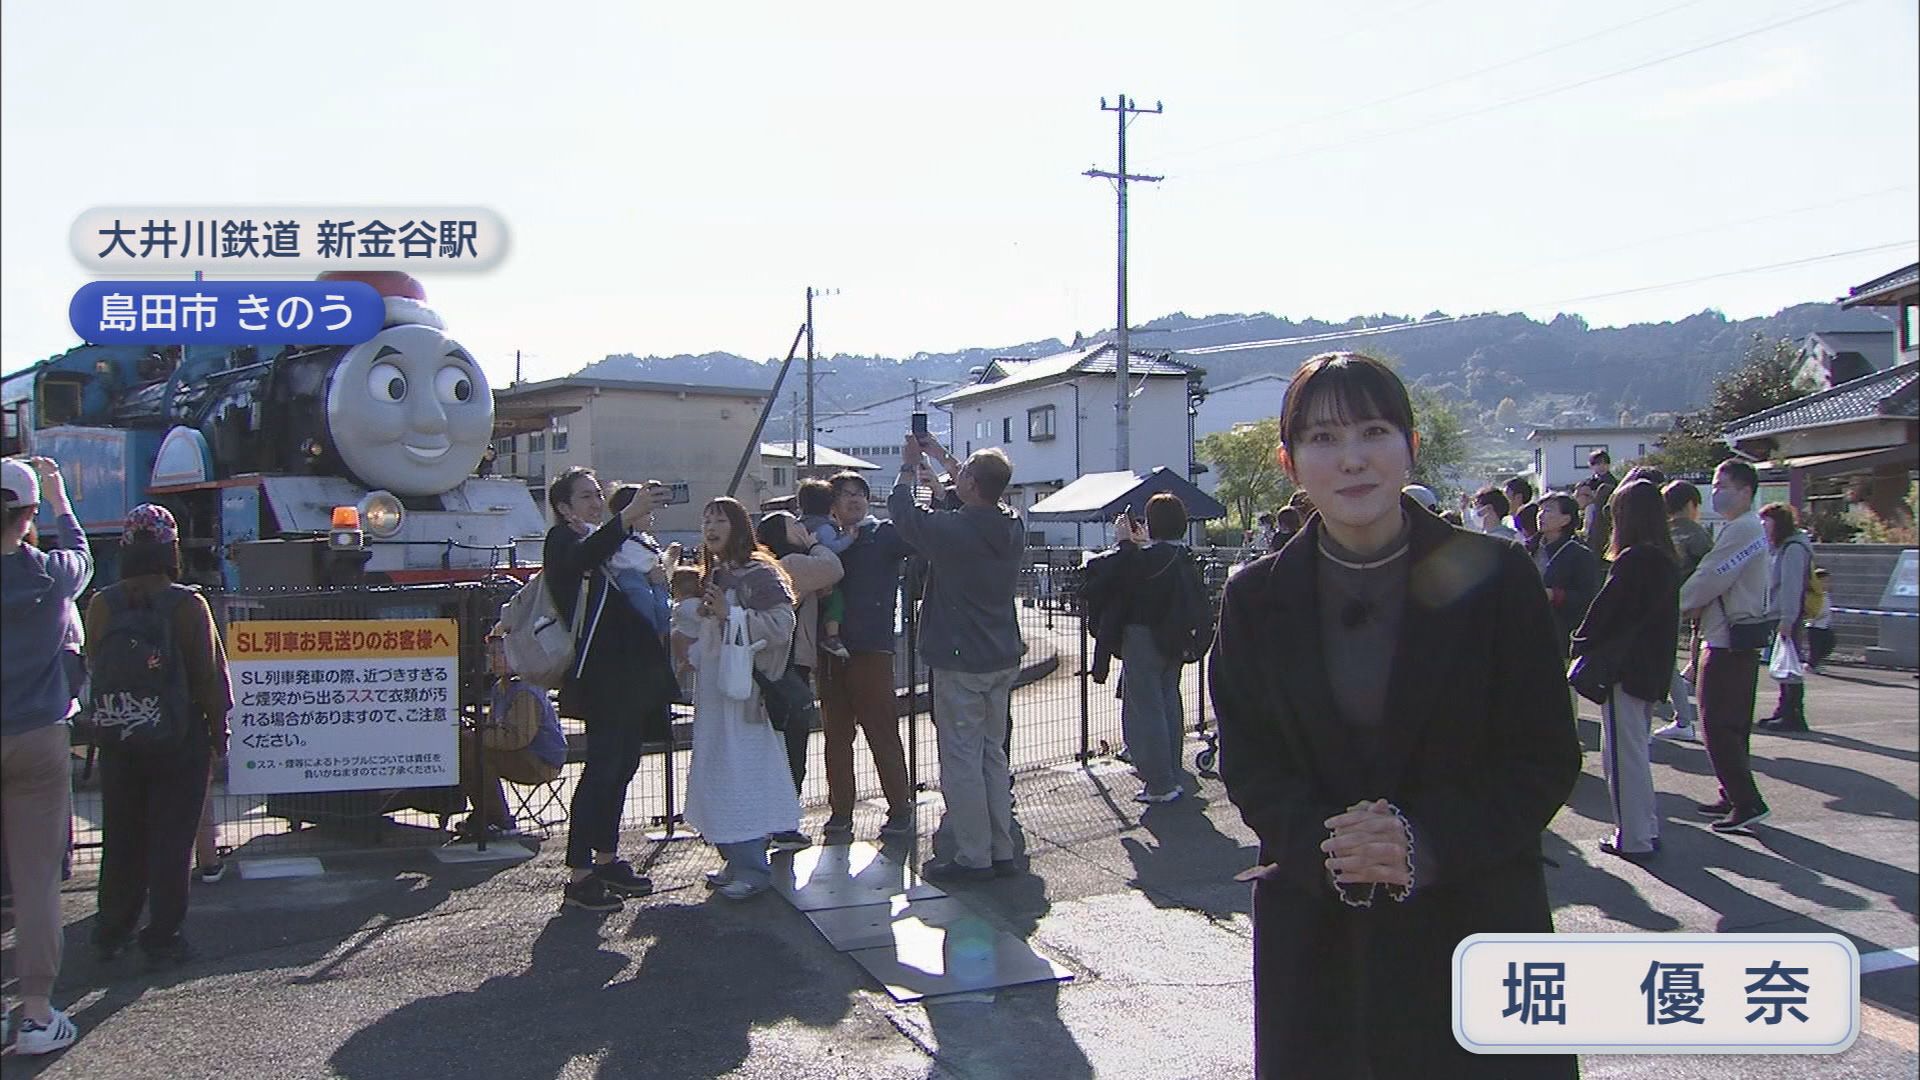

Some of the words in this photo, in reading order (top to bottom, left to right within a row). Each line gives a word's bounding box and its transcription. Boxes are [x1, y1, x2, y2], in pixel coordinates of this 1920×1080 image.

[237, 628, 449, 653] SL列車お見送りのお客様へ
[241, 667, 448, 686] SL列車発車の際、近づきすぎる
[241, 687, 447, 706] と煙突から出るススで衣類が汚
[241, 707, 447, 727] れる場合がありますので、ご注意
[242, 733, 307, 749] ください。
